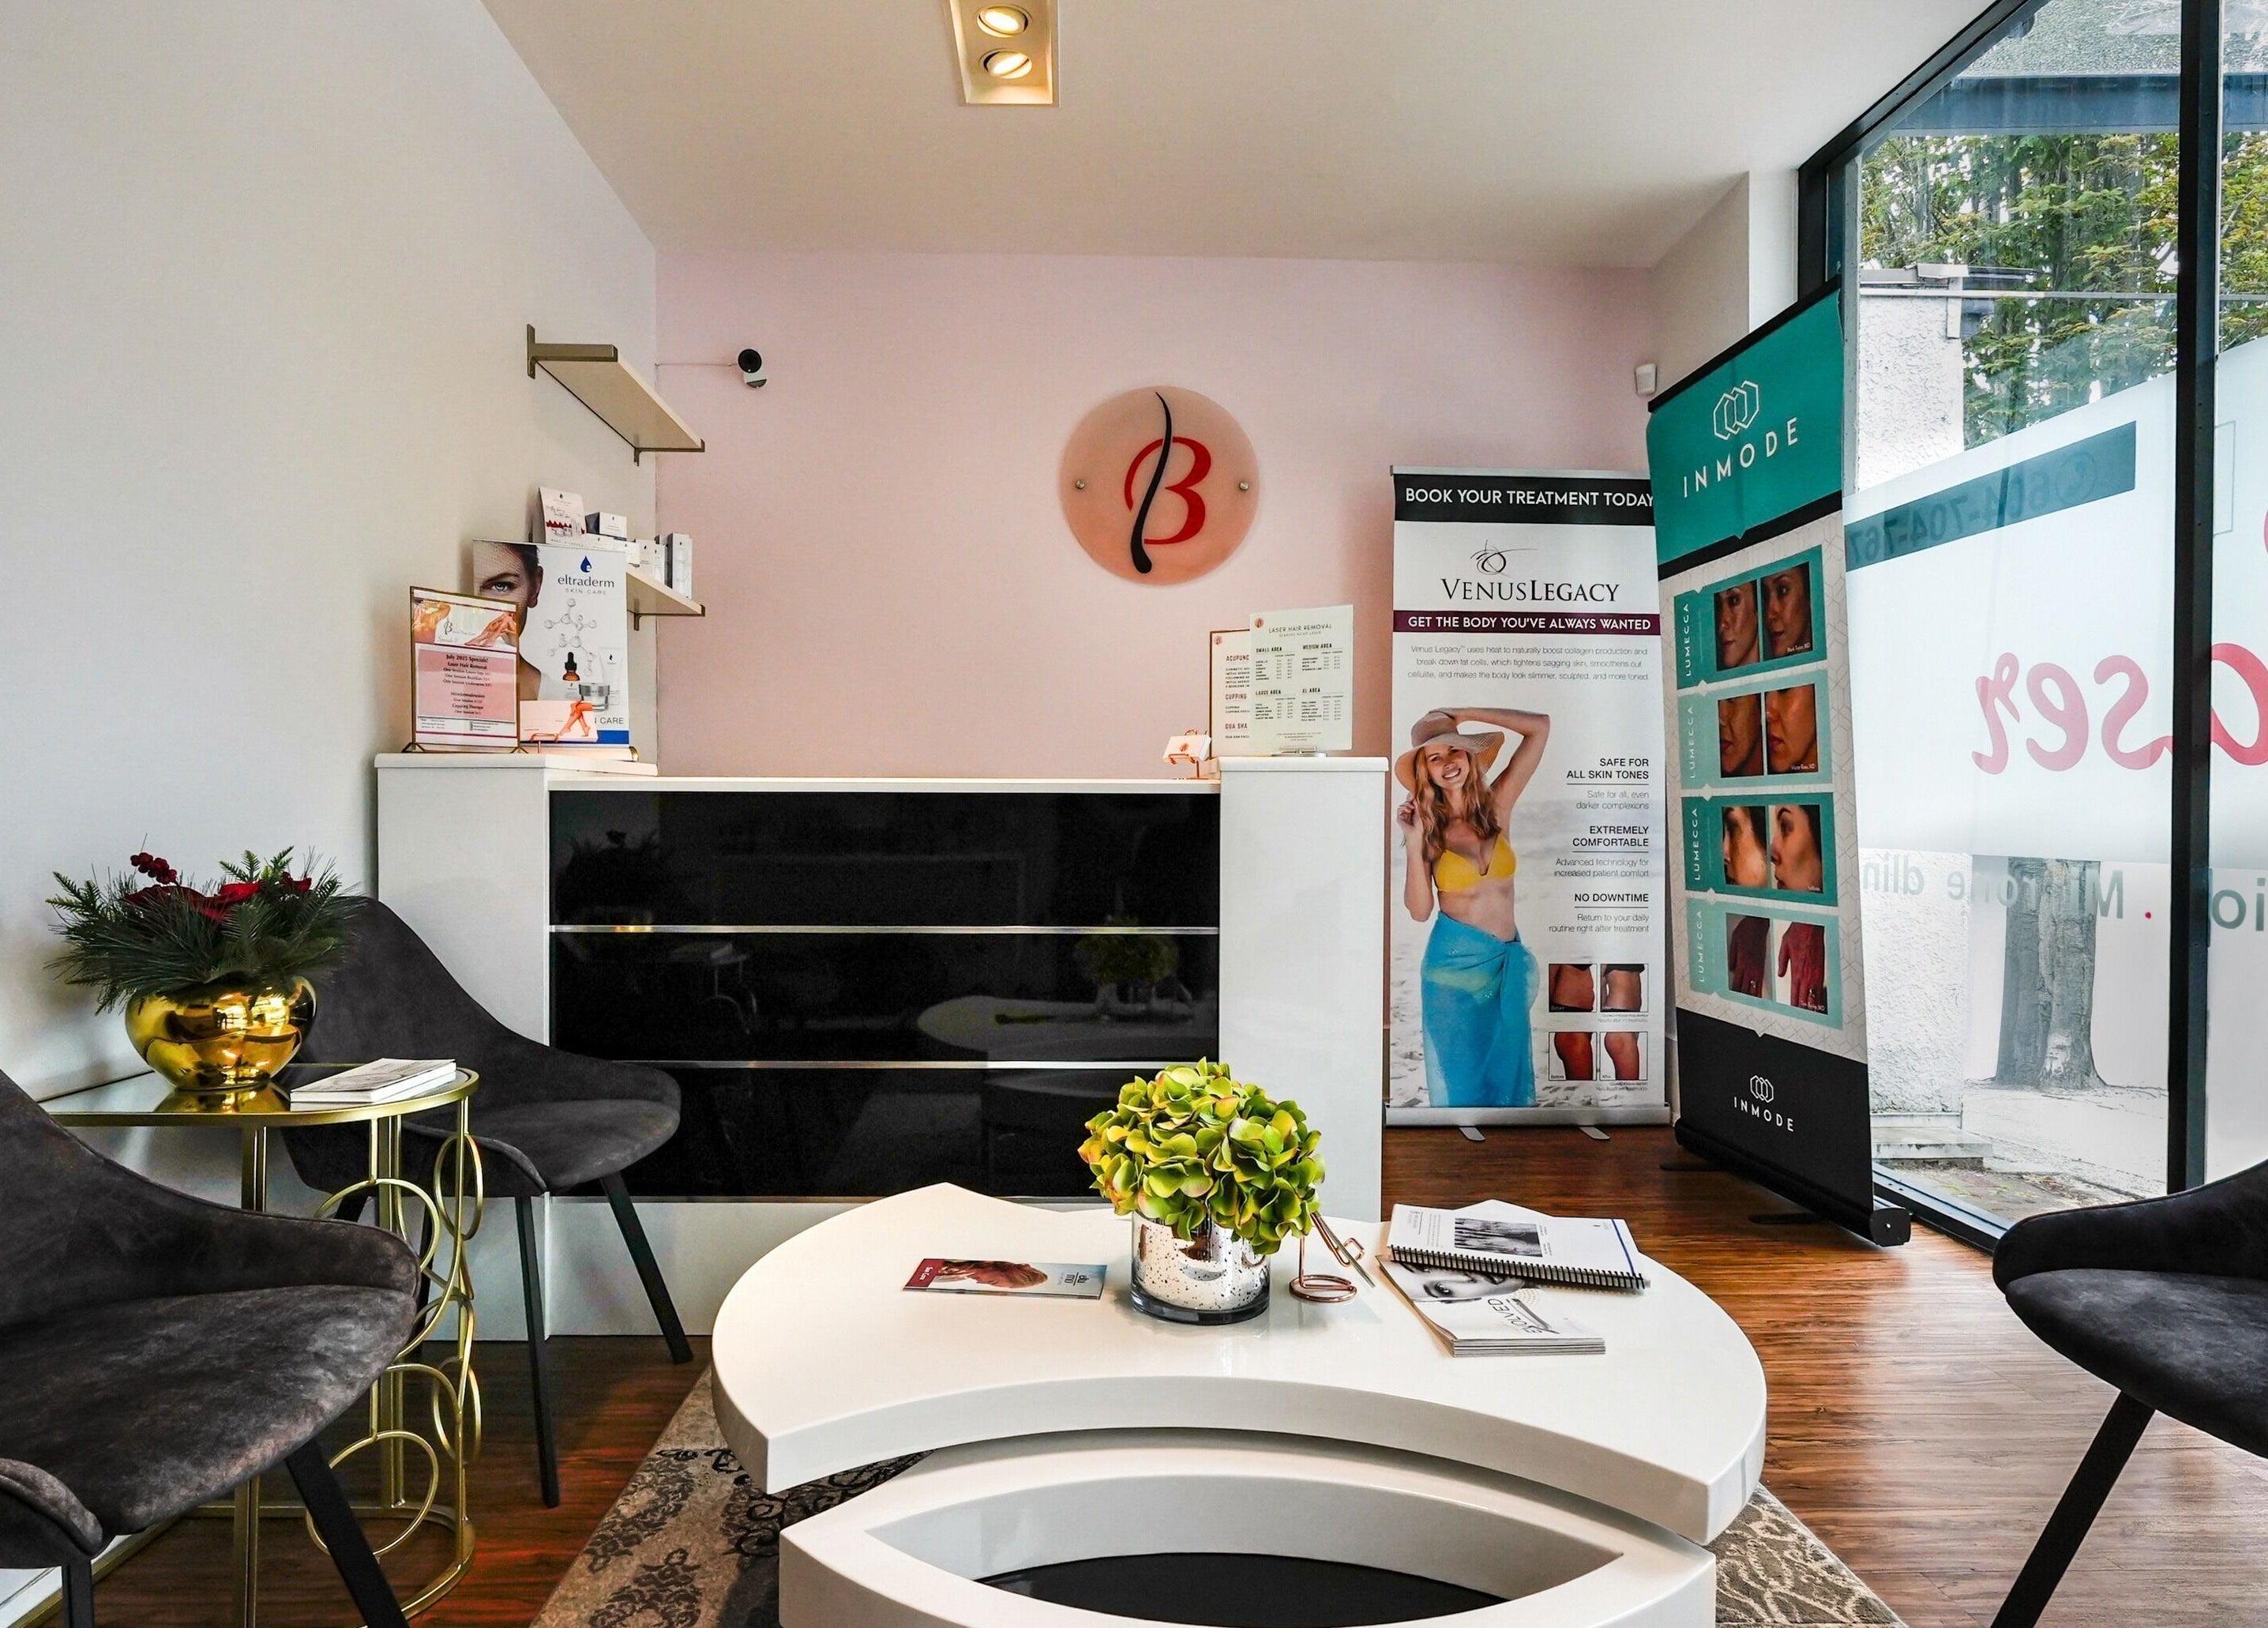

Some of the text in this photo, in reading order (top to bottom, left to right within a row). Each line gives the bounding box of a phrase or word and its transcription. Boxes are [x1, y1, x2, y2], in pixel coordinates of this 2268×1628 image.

[1684, 417, 1798, 498] INMODE
[1406, 487, 1654, 507] BOOK YOUR TREATMENT TODAY
[558, 574, 614, 588] eltraderm
[1408, 616, 1650, 630] GET THE BODY YOU'VE ALWAYS WANTED
[1512, 646, 1541, 656] naturally
[1564, 647, 1594, 656] collagen
[1514, 659, 1541, 668] tightens
[1542, 660, 1571, 668] sagging
[1687, 706, 1695, 779] LUMECCA
[1567, 770, 1585, 779] ALL
[1601, 801, 1649, 810] complexions
[1572, 838, 1649, 847] COMFORTABLE
[1692, 808, 1700, 881] LUMECCA
[1596, 858, 1638, 867] technology
[1593, 870, 1618, 878] patient
[1575, 893, 1649, 902] NO DOWNTIME
[1632, 913, 1649, 923] daily
[1577, 925, 1593, 934] right
[1696, 911, 1705, 983] LUMECCA
[1734, 1096, 1794, 1132] INMODE
